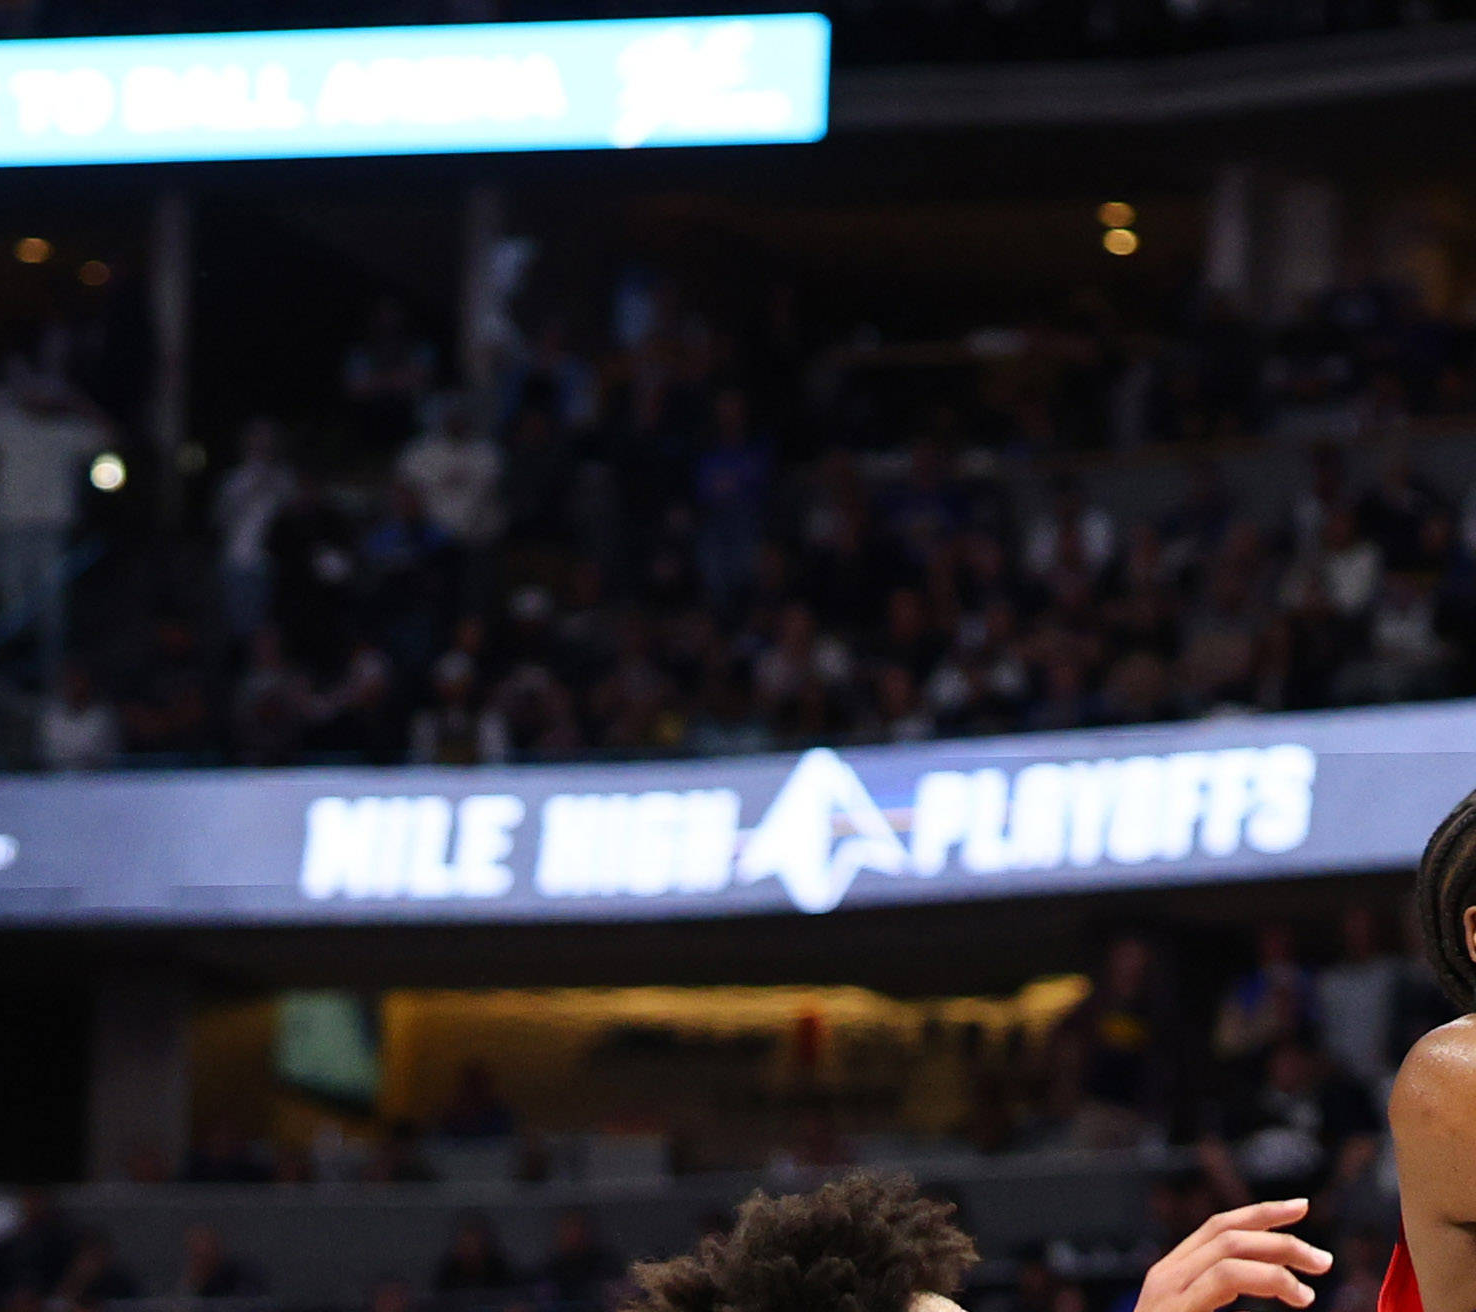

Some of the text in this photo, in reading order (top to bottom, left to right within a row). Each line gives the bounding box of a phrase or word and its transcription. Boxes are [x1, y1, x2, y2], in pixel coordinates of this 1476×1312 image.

[9, 69, 114, 135] TO
[302, 794, 524, 899] MILE
[913, 743, 1317, 878] PLAYOFFS
